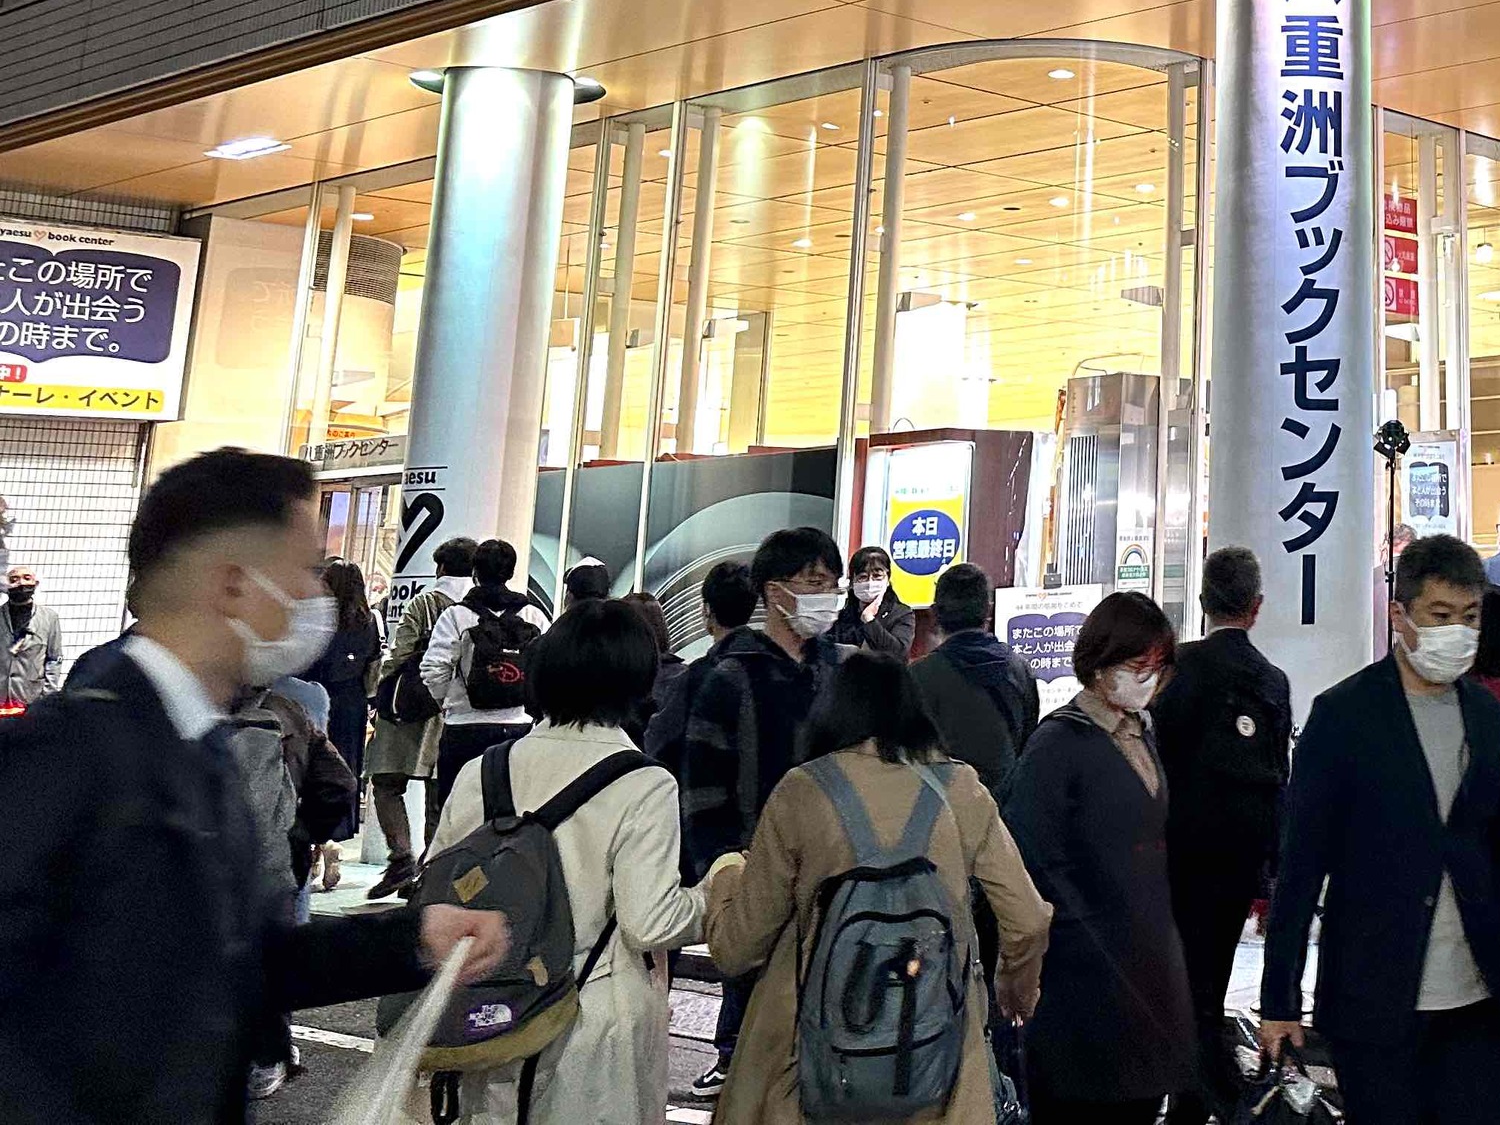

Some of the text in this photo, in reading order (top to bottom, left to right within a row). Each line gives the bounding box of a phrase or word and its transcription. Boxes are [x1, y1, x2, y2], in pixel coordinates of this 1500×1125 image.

[0, 228, 115, 246] yaesu book center
[0, 288, 146, 323] 人が出会う
[0, 321, 120, 354] の時まで。
[303, 437, 399, 462] 八重洲ブックセンター
[912, 517, 938, 536] 本日
[893, 539, 956, 560] 営業最終日
